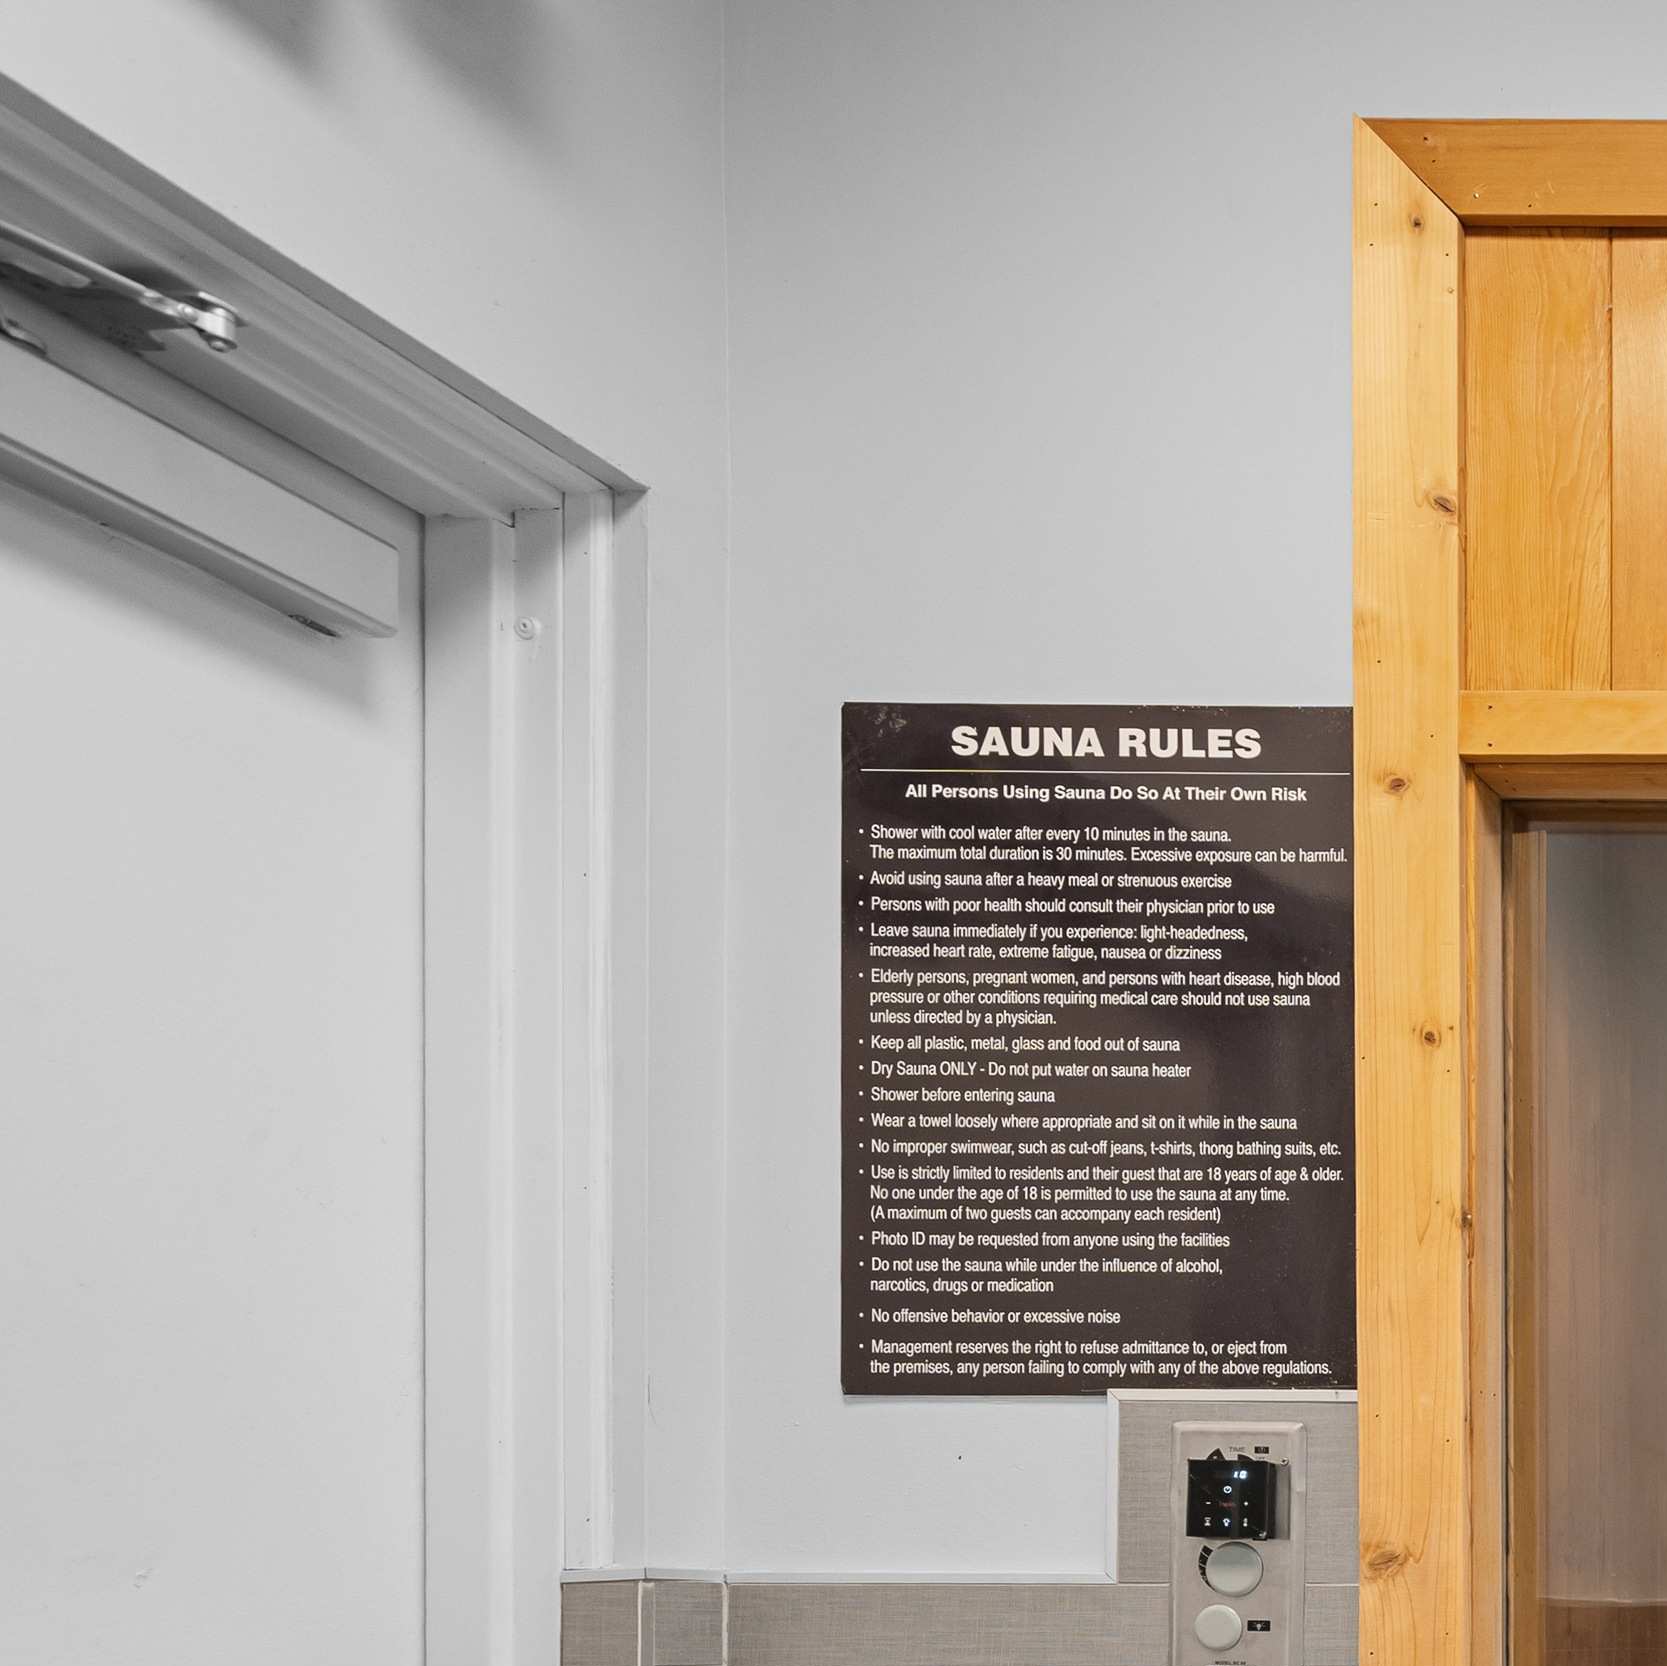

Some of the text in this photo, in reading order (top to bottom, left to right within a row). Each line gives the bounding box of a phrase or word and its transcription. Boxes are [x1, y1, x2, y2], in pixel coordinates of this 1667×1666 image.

[950, 725, 1261, 759] SAUNA RULES
[904, 783, 1307, 803] All Persons Using Sauna Do So At Their Own Risk
[870, 823, 1231, 844] Shower with cool water after every 10 minutes in the sauna.
[868, 843, 1347, 866] The maximum total duration is 30 minutes. Excessive exposure can be harmful.
[870, 921, 1248, 943] Leave sauna immediately if you experience: light-headedness,
[869, 942, 1222, 962] increased heart rate, extreme fatigue, nausea or dizziness
[871, 967, 1340, 990] Elderly persons, pregnant women, and persons with heart disease, high blood
[869, 1008, 1056, 1028] unless directed by a physician.
[870, 1034, 1181, 1054] Keep all plastic, metal, glass and food out of sauna
[871, 1060, 893, 1079] Dry
[896, 1060, 937, 1076] Sauna
[939, 1060, 977, 1076] ONLY
[988, 1061, 1006, 1076] Do
[1009, 1062, 1029, 1076] not
[1031, 1062, 1052, 1080] put
[1054, 1062, 1090, 1077] water
[1091, 1065, 1108, 1077] on
[1110, 1065, 1149, 1077] sauna
[1151, 1062, 1192, 1078] heater
[870, 1086, 1055, 1106] Shower before entering sauna
[871, 1138, 1341, 1159] No improper swimwear, such as cut-off jeans, t-shirts, thong bathing suits, etc.
[870, 1204, 1221, 1224] (A maximum of two guests can accompany each resident)
[871, 1230, 1230, 1251] Photo ID may be requested from anyone using the facilities
[870, 1276, 1054, 1296] narcotics, drugs or medication
[871, 1307, 1121, 1324] No offensive behavior or excessive noise
